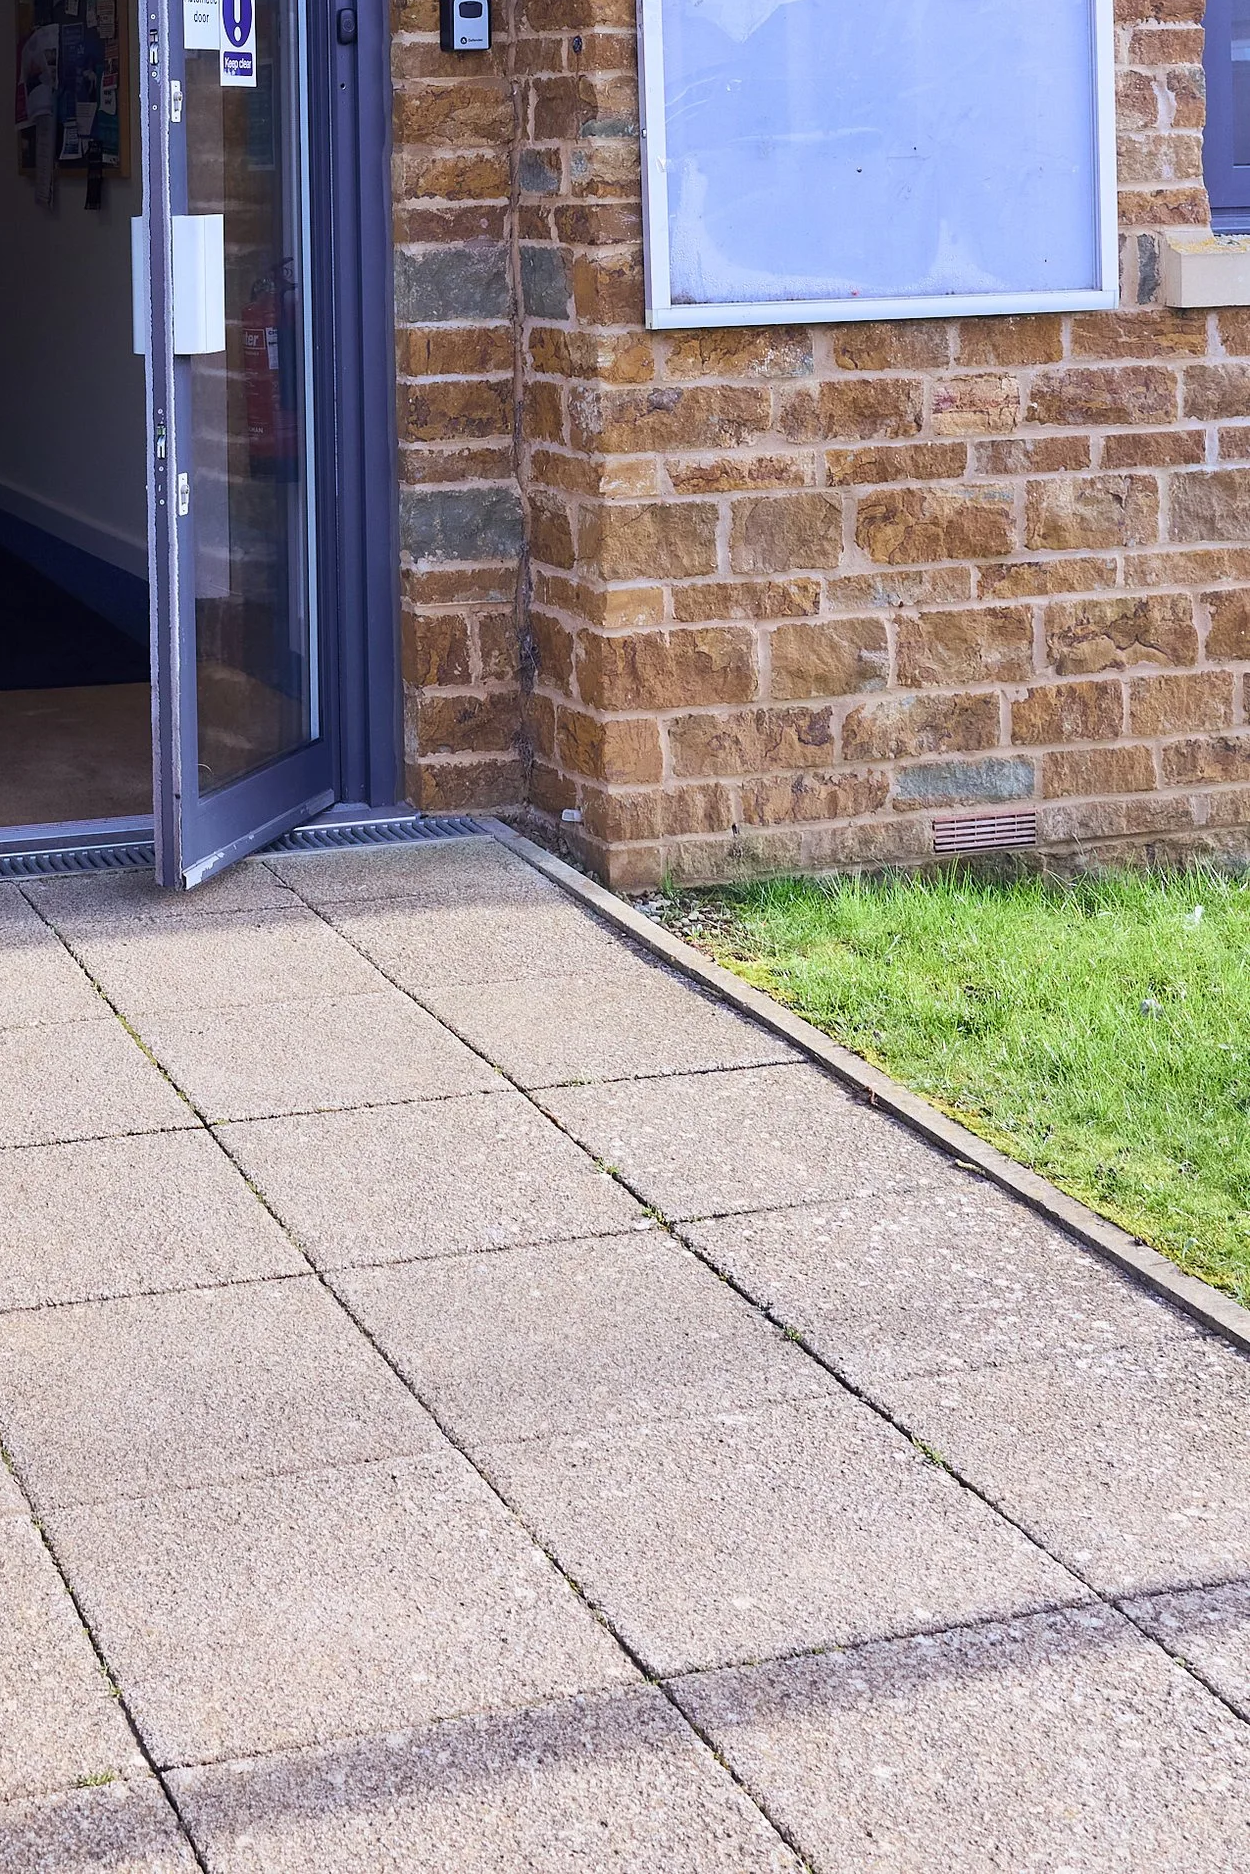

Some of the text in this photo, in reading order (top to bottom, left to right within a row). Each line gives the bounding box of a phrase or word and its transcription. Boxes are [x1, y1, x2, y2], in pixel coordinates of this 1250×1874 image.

[193, 11, 210, 23] door
[224, 56, 252, 71] Keep clear
